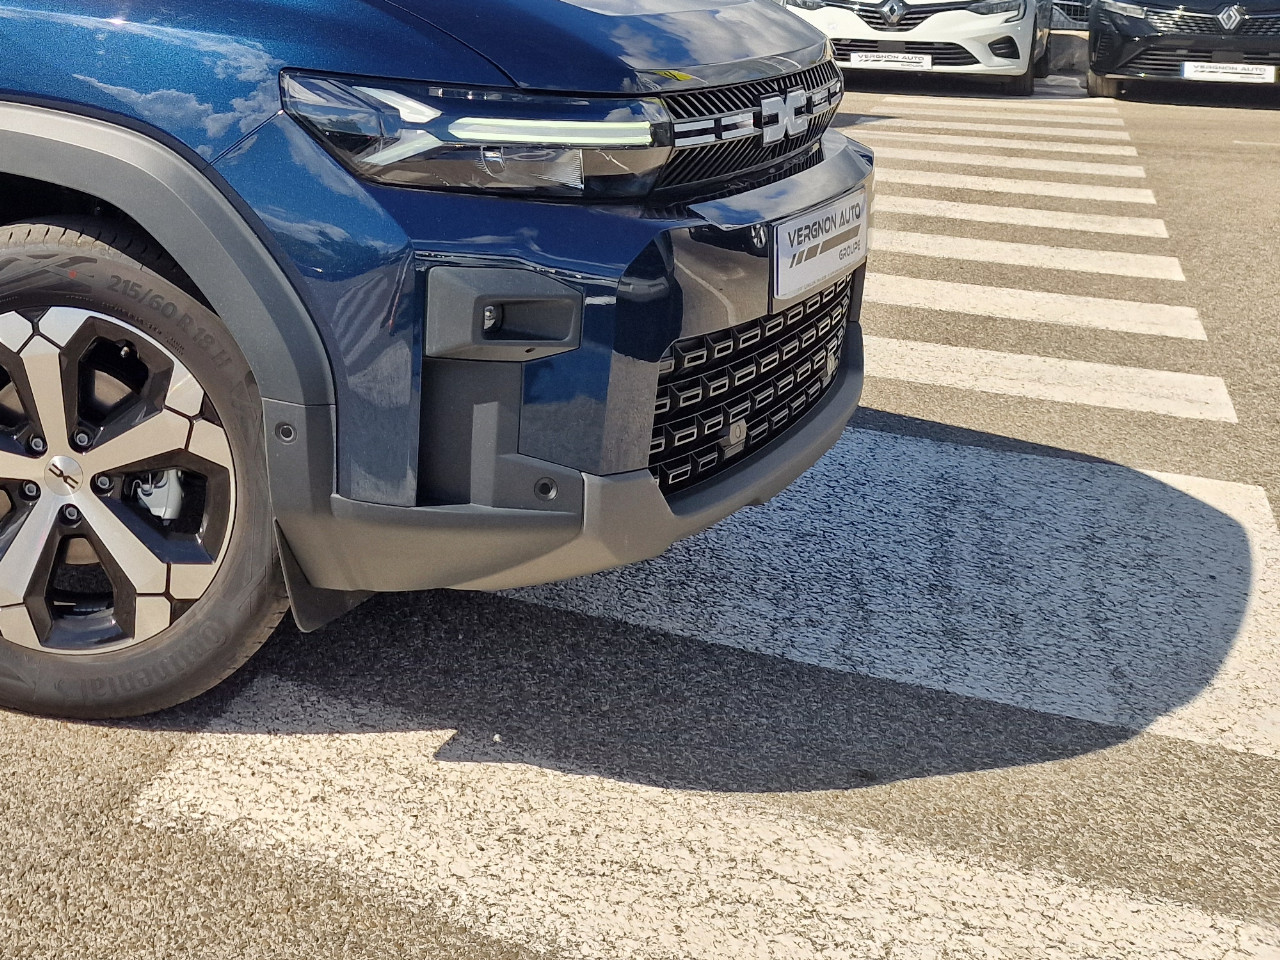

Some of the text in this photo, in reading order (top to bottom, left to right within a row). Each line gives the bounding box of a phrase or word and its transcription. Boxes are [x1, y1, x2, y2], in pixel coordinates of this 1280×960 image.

[787, 202, 861, 248] VERGNON AUTO
[838, 240, 861, 260] GROUPE
[107, 274, 178, 320] 215/60
